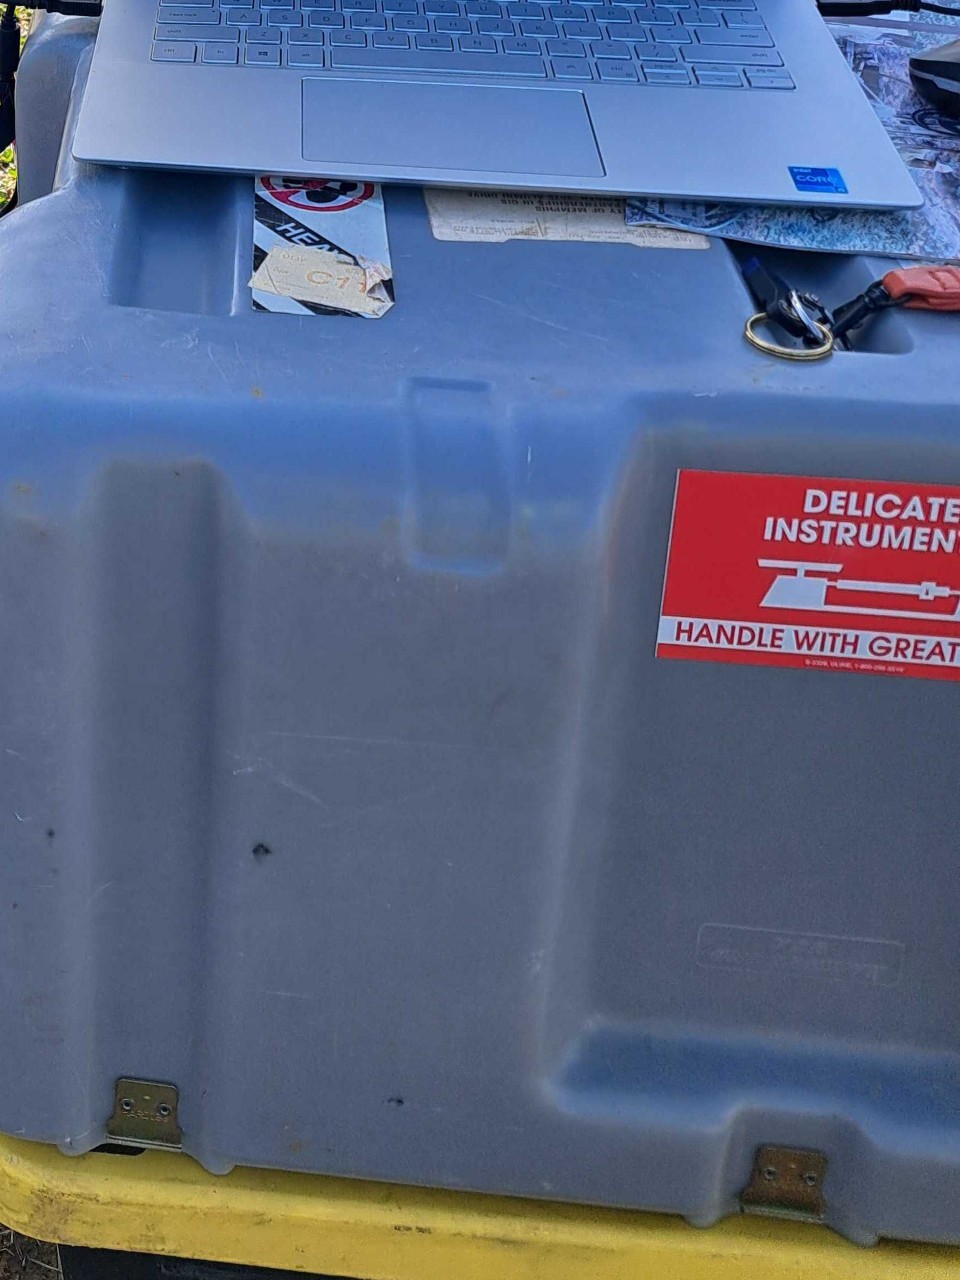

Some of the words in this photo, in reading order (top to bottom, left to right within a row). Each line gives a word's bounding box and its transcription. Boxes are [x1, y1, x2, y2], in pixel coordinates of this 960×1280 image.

[803, 488, 960, 524] DELICATE
[763, 516, 960, 554] INSTRUMEN
[675, 620, 784, 649] HANDLE
[792, 629, 860, 654] WITH
[868, 636, 960, 664] GREAT
